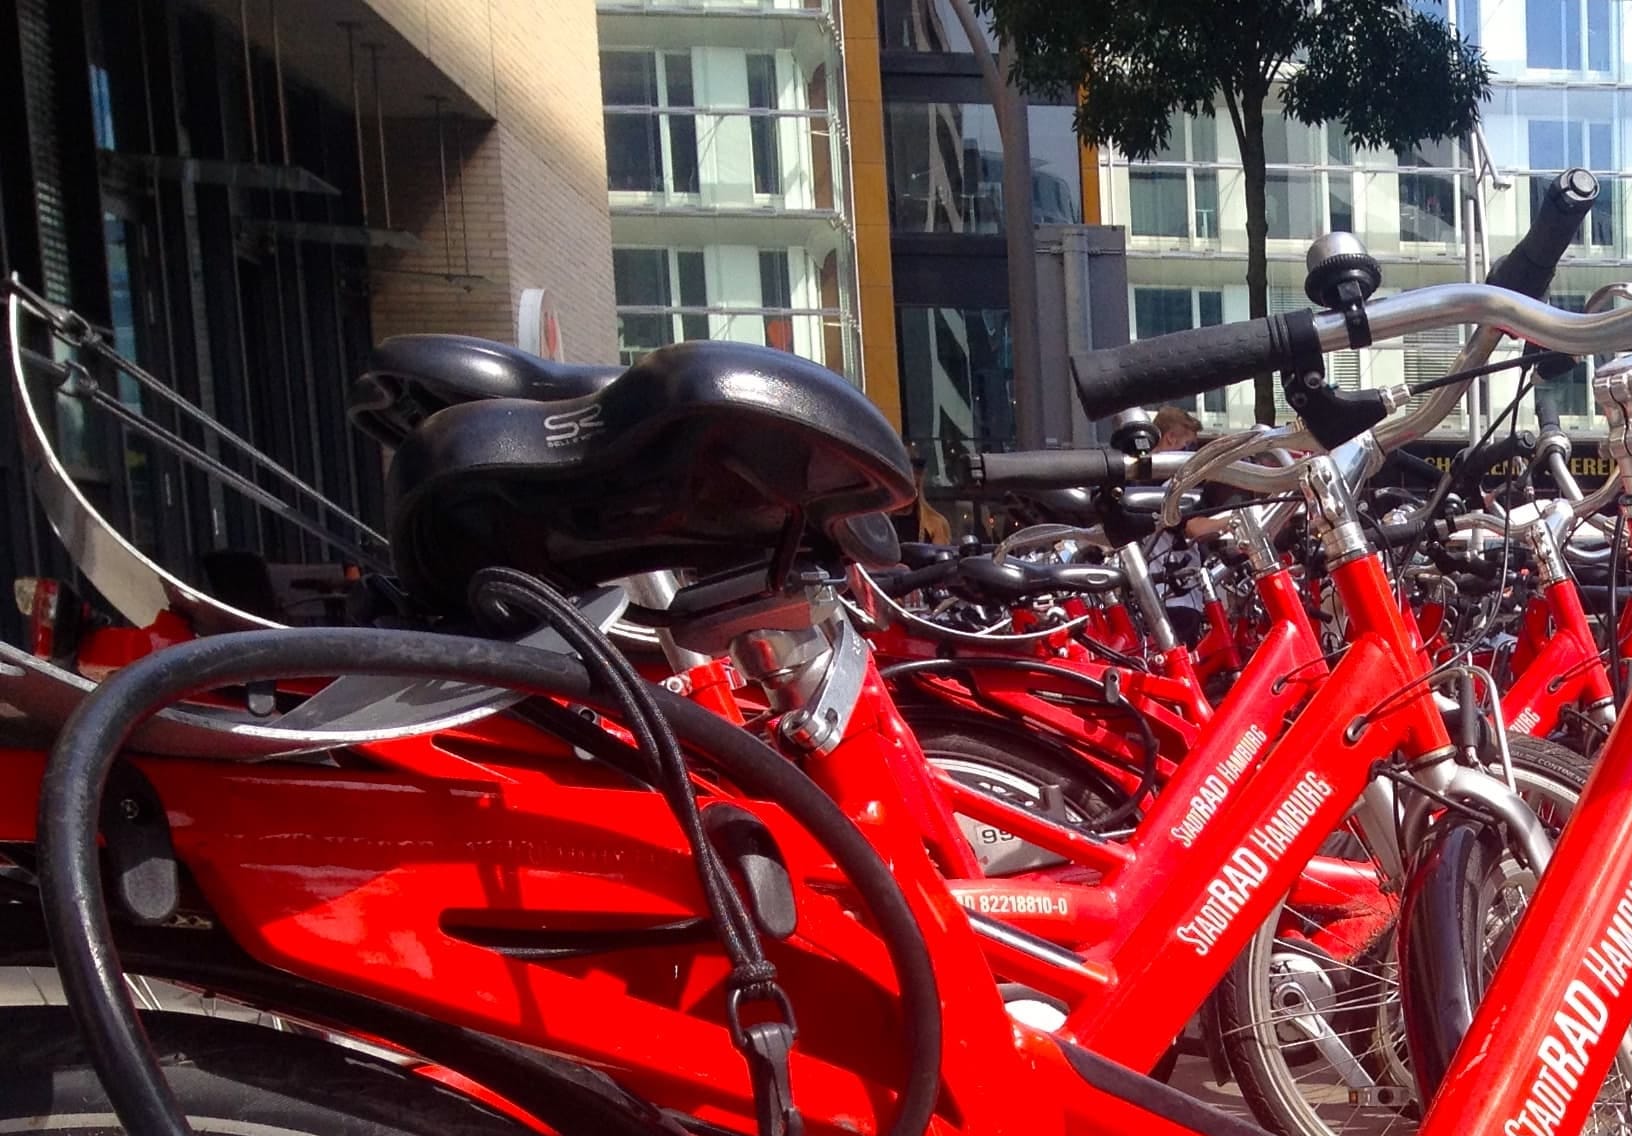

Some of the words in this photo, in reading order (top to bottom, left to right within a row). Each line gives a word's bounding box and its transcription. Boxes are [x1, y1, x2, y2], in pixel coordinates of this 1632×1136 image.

[1216, 724, 1267, 785] HAMBURG
[1249, 771, 1333, 861] HAMBURG
[980, 896, 1068, 915] 82218810-0
